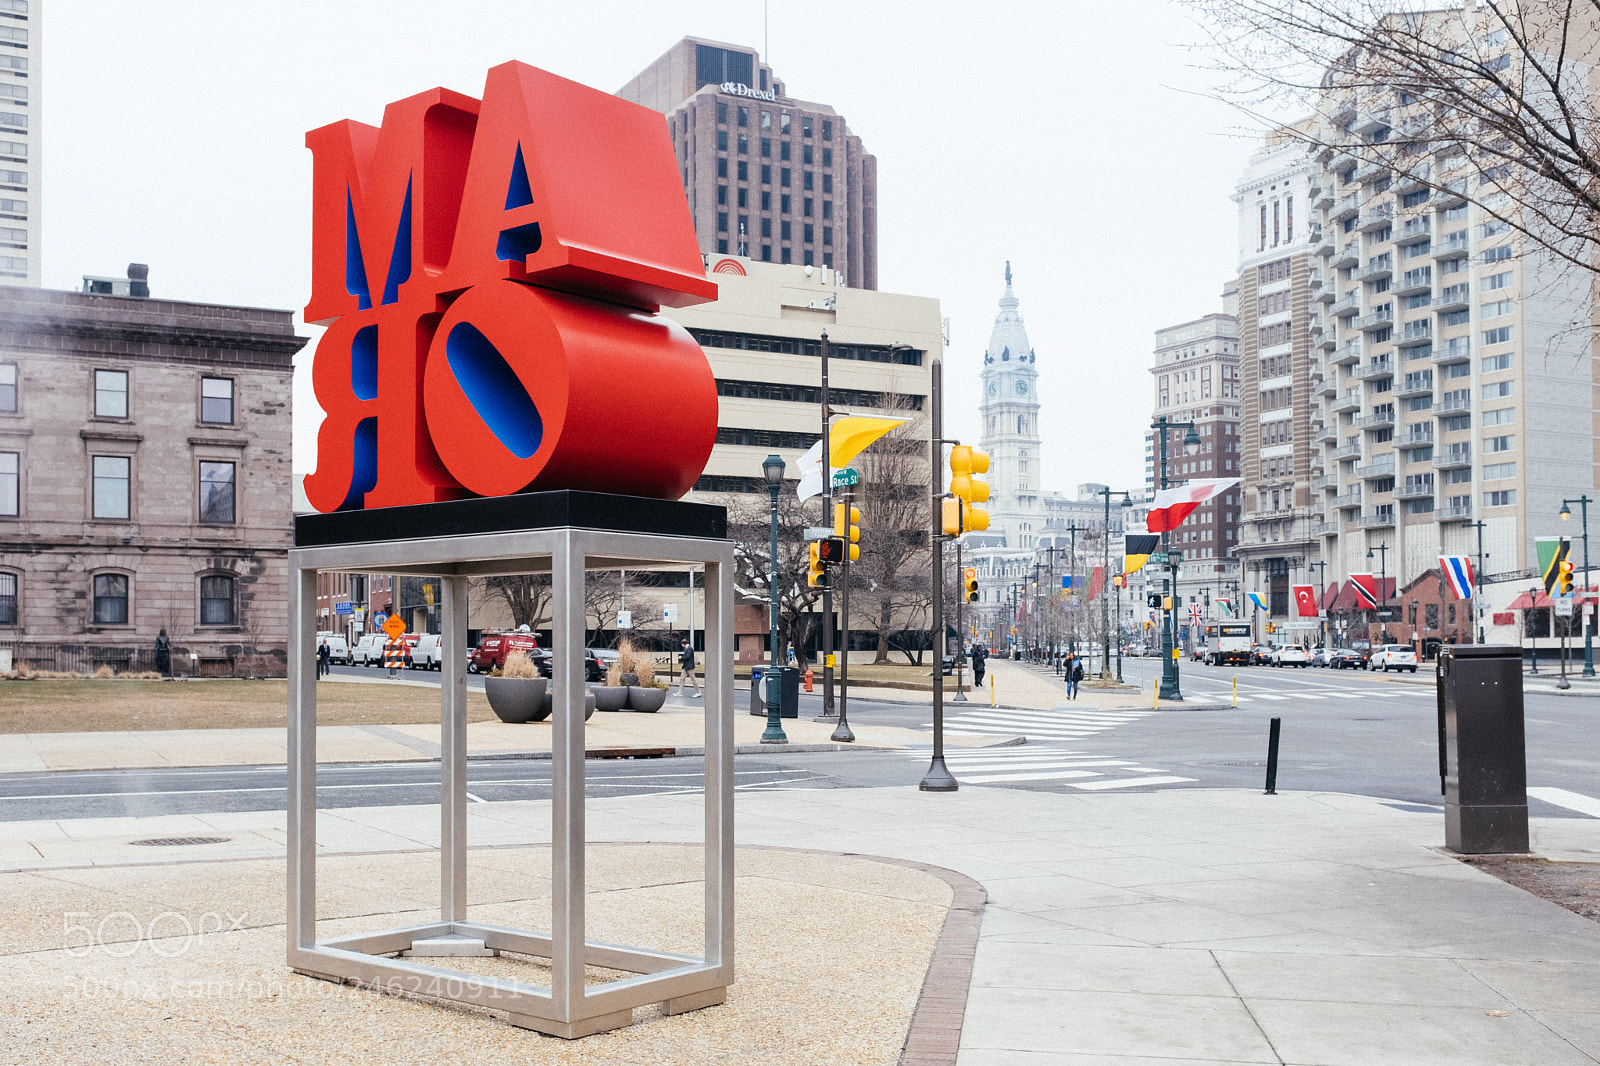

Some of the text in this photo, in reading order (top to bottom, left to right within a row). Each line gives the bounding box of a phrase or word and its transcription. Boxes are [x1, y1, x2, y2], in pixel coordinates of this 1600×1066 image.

[737, 82, 775, 102] Drexel
[833, 474, 857, 488] Race St
